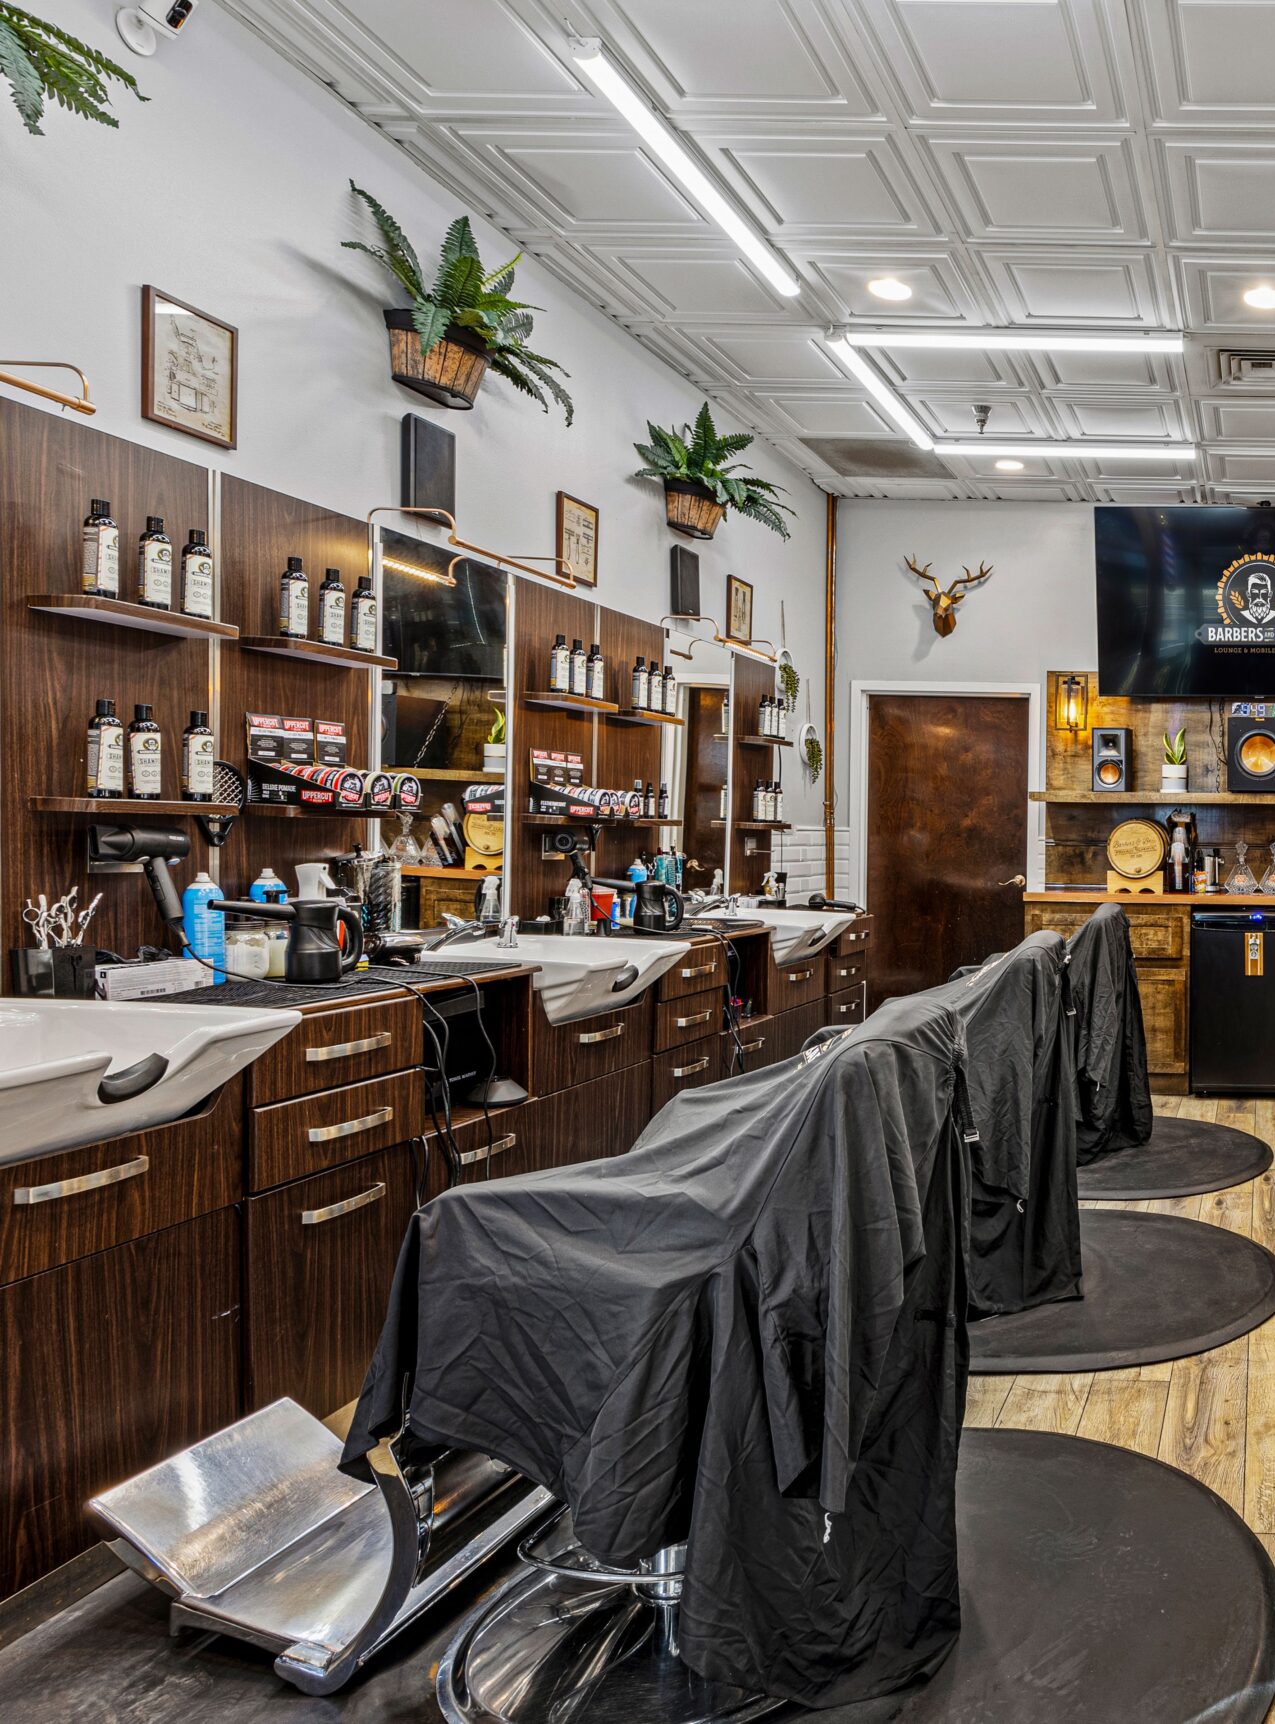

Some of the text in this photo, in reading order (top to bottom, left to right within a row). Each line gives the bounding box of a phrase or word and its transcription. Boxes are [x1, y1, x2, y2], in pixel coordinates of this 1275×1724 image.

[1208, 628, 1263, 642] BARBERS
[284, 720, 310, 731] UPPERCUT
[318, 724, 343, 734] UPPERCUT
[302, 790, 333, 800] UPPERCUT
